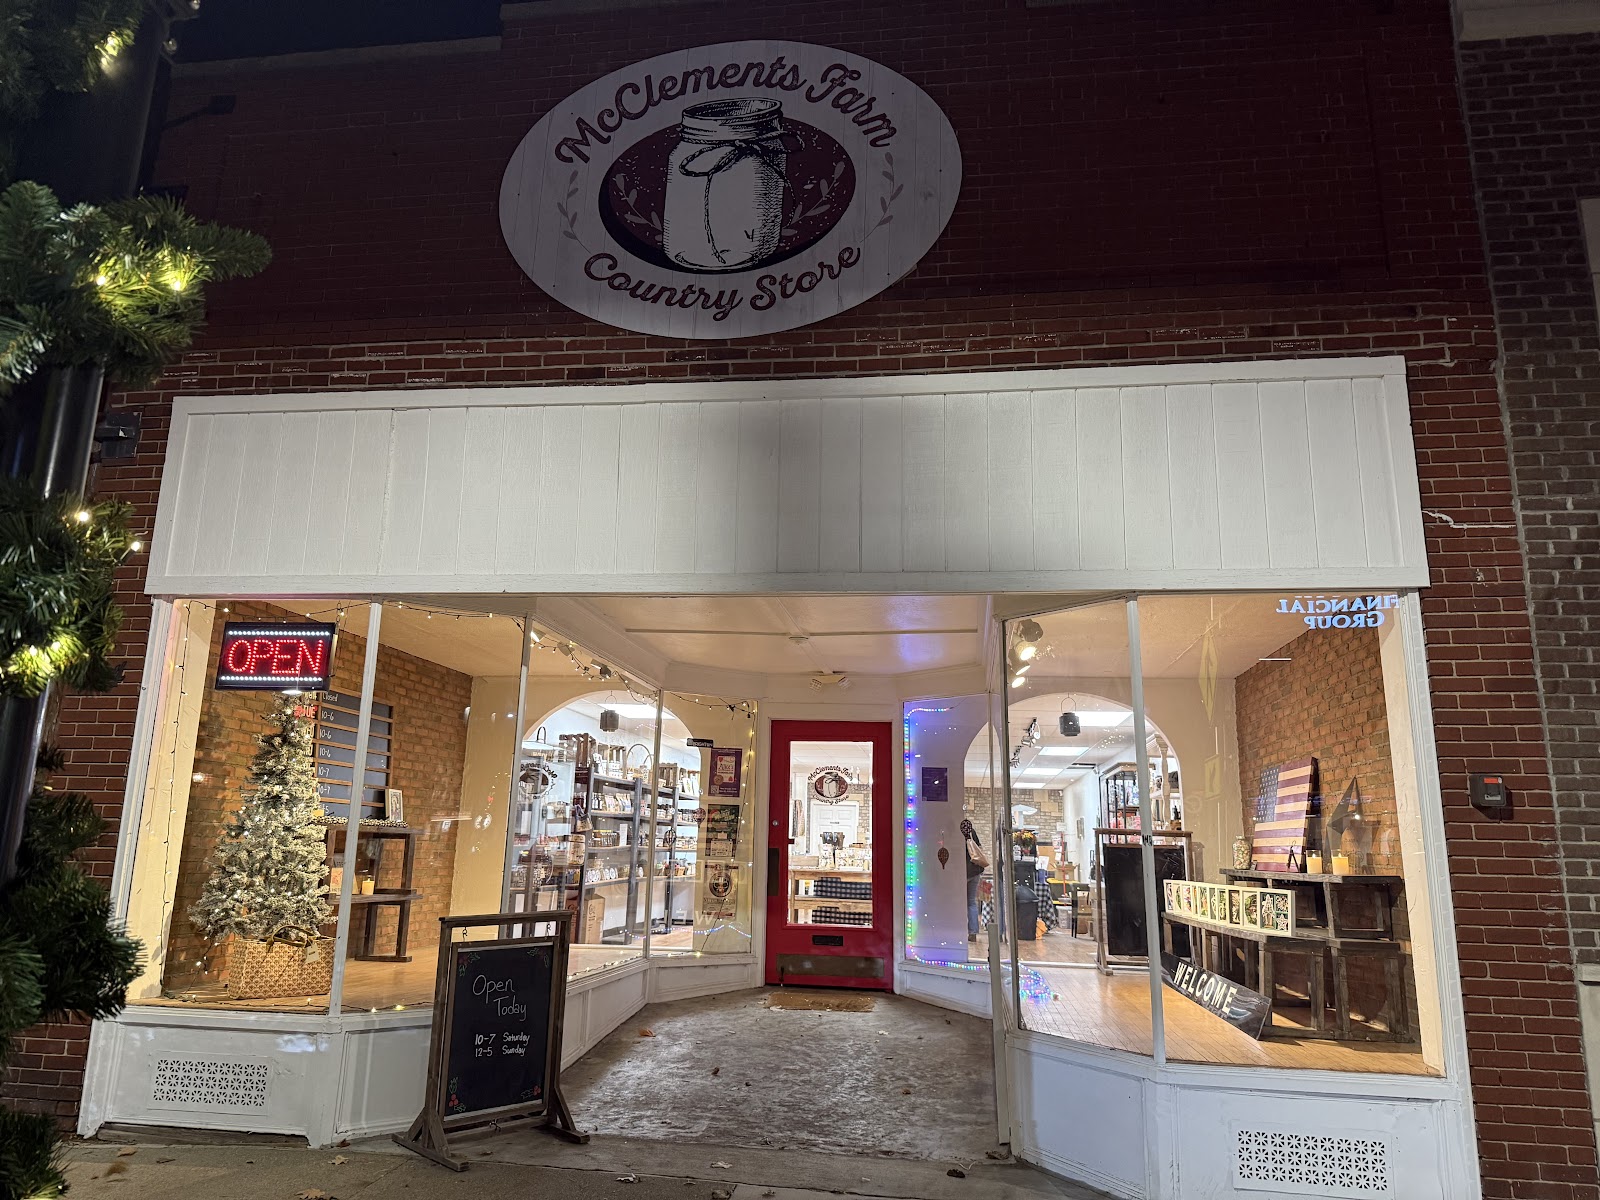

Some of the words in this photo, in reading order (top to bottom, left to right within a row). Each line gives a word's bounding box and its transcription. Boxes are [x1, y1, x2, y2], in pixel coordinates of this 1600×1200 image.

[555, 56, 806, 164] McClements
[805, 63, 902, 148] Farm
[584, 252, 743, 321] Country
[749, 246, 861, 311] Store
[228, 639, 323, 674] OPEN
[321, 710, 334, 721] 10-6
[320, 728, 331, 739] 10-6
[320, 747, 331, 758] 10-6
[318, 766, 330, 777] 10-7
[808, 765, 841, 782] McClements
[472, 974, 515, 1004] Open
[1173, 961, 1238, 1014] WELCOME
[493, 995, 527, 1021] Today
[474, 1033, 496, 1046] 10-7
[502, 1031, 530, 1047] Saturday
[475, 1046, 493, 1058] 12-5
[502, 1044, 526, 1057] Sunday
